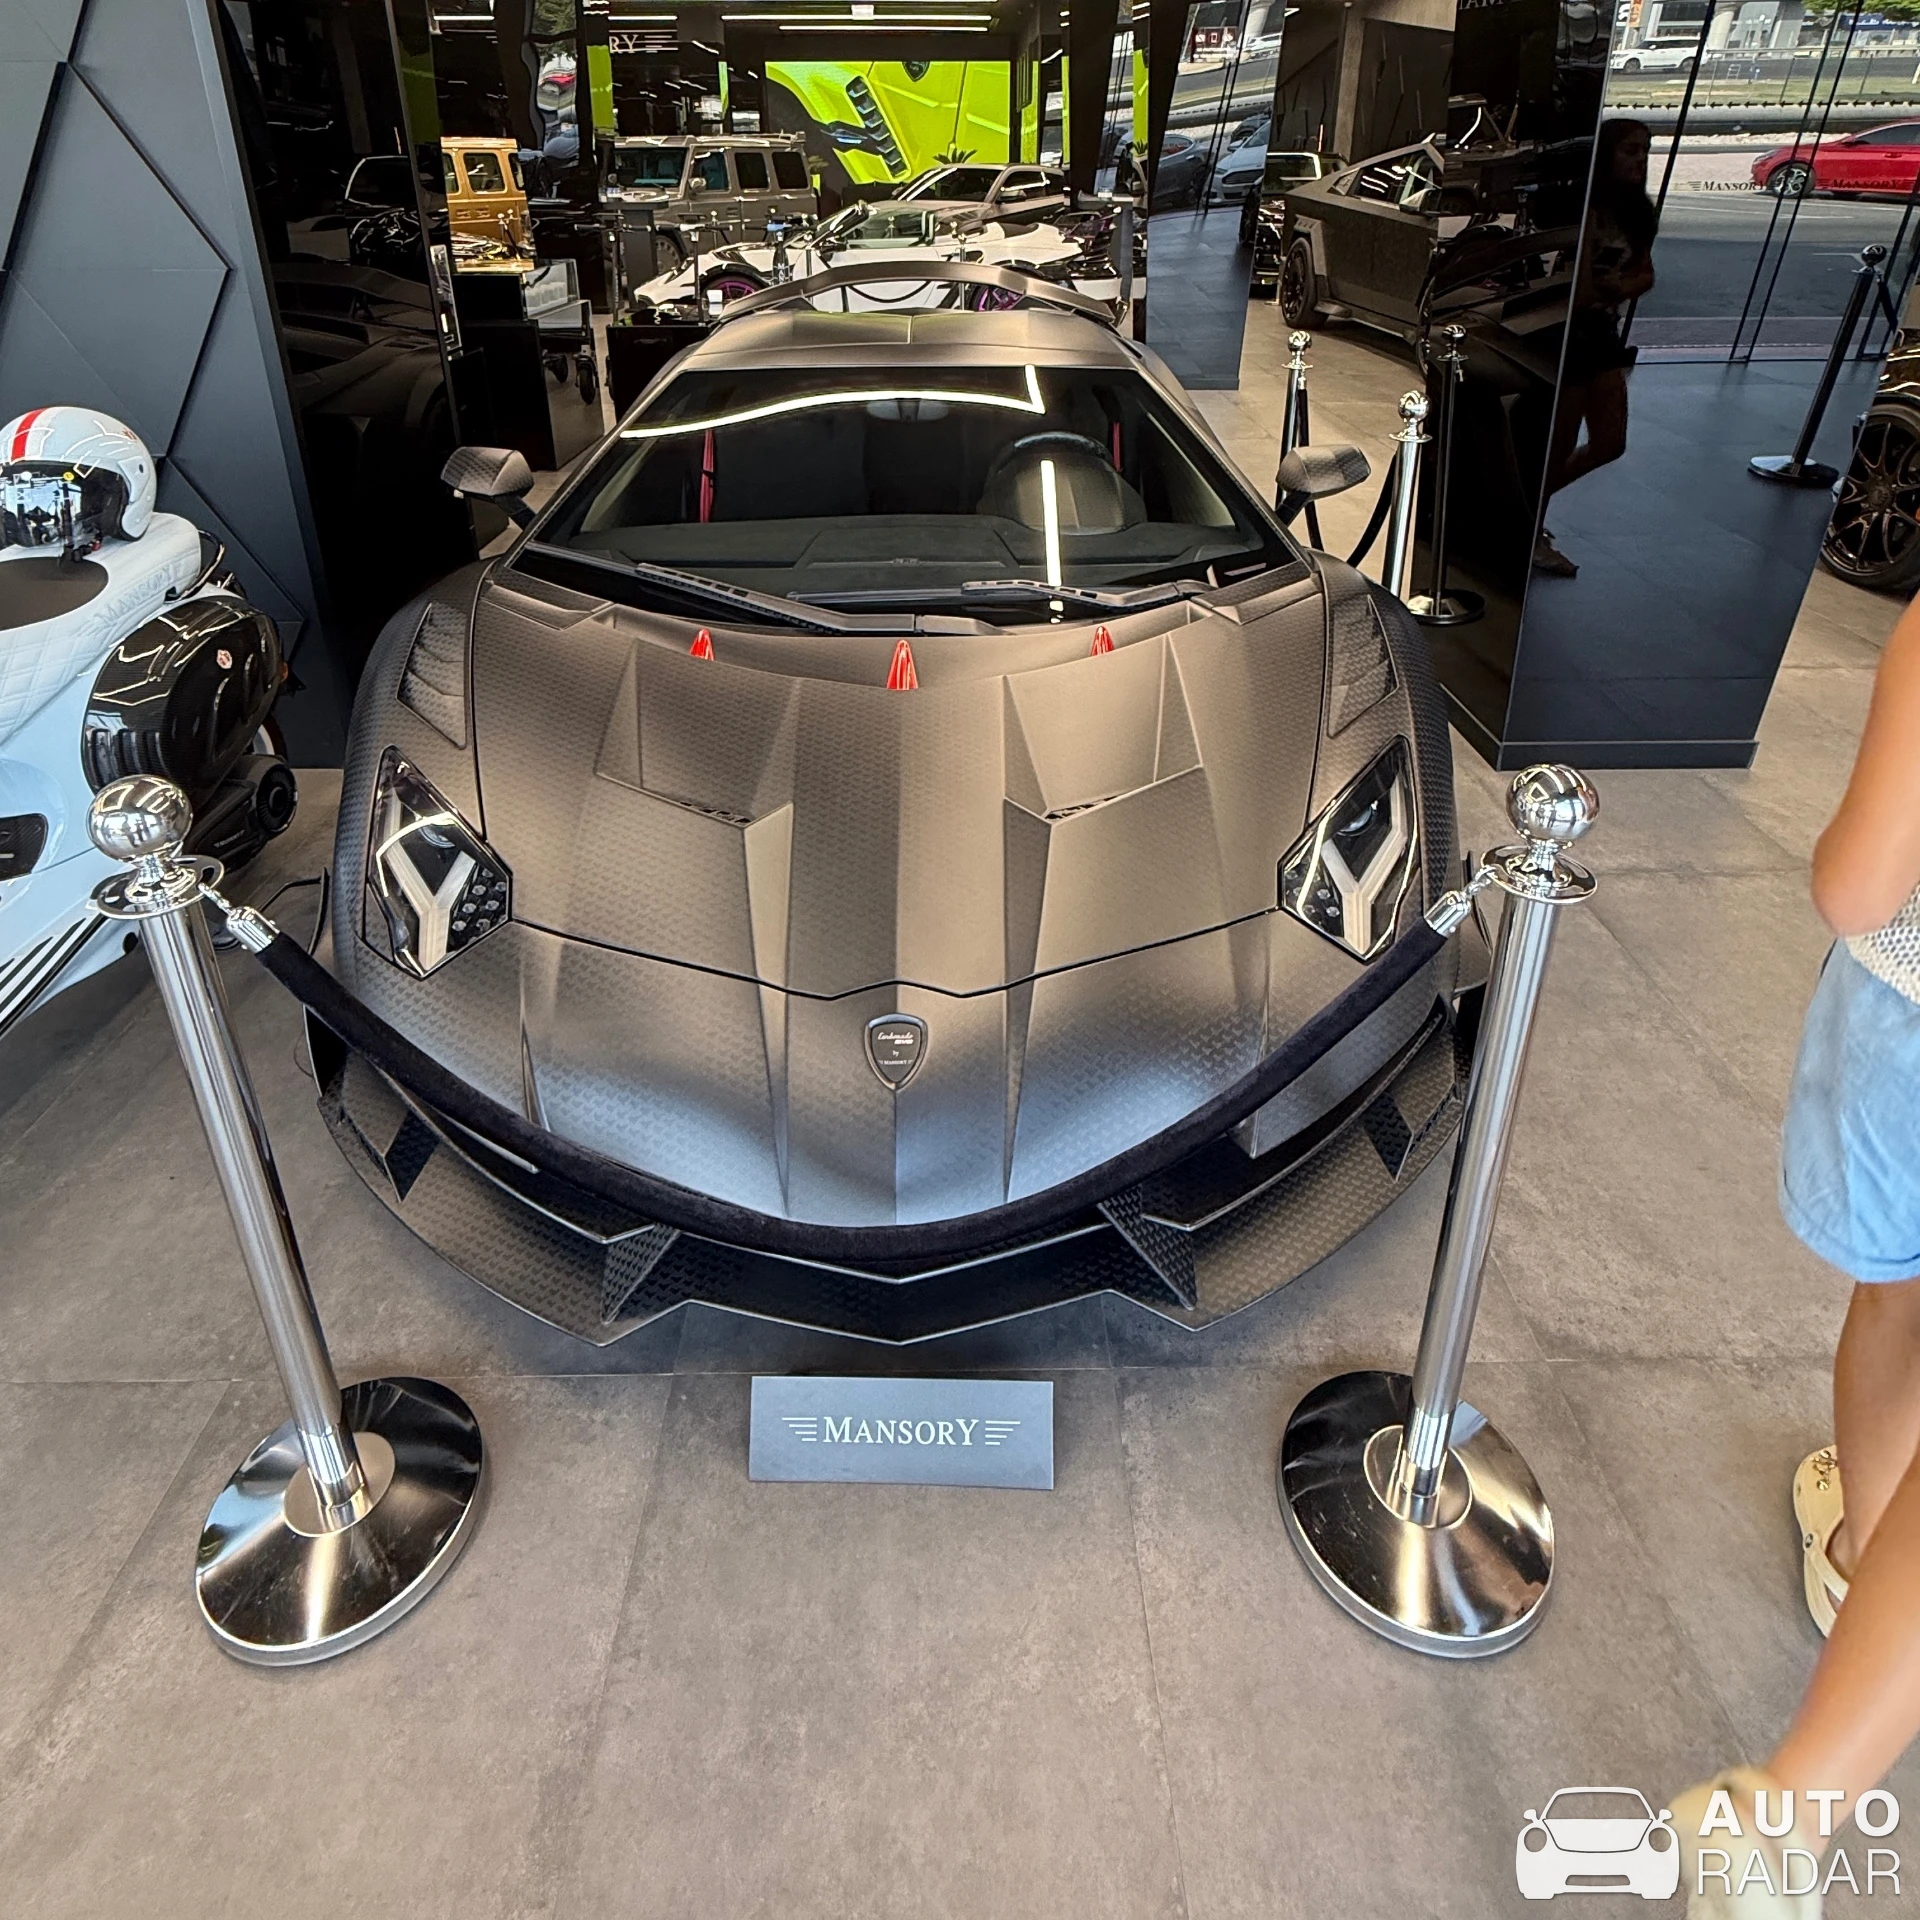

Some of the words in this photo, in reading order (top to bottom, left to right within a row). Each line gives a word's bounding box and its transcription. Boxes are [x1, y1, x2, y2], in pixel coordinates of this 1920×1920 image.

[1702, 180, 1764, 191] MANSORY
[1833, 179, 1900, 189] MANSORY
[93, 563, 178, 628] MANSORY
[823, 1416, 979, 1445] MANSORY
